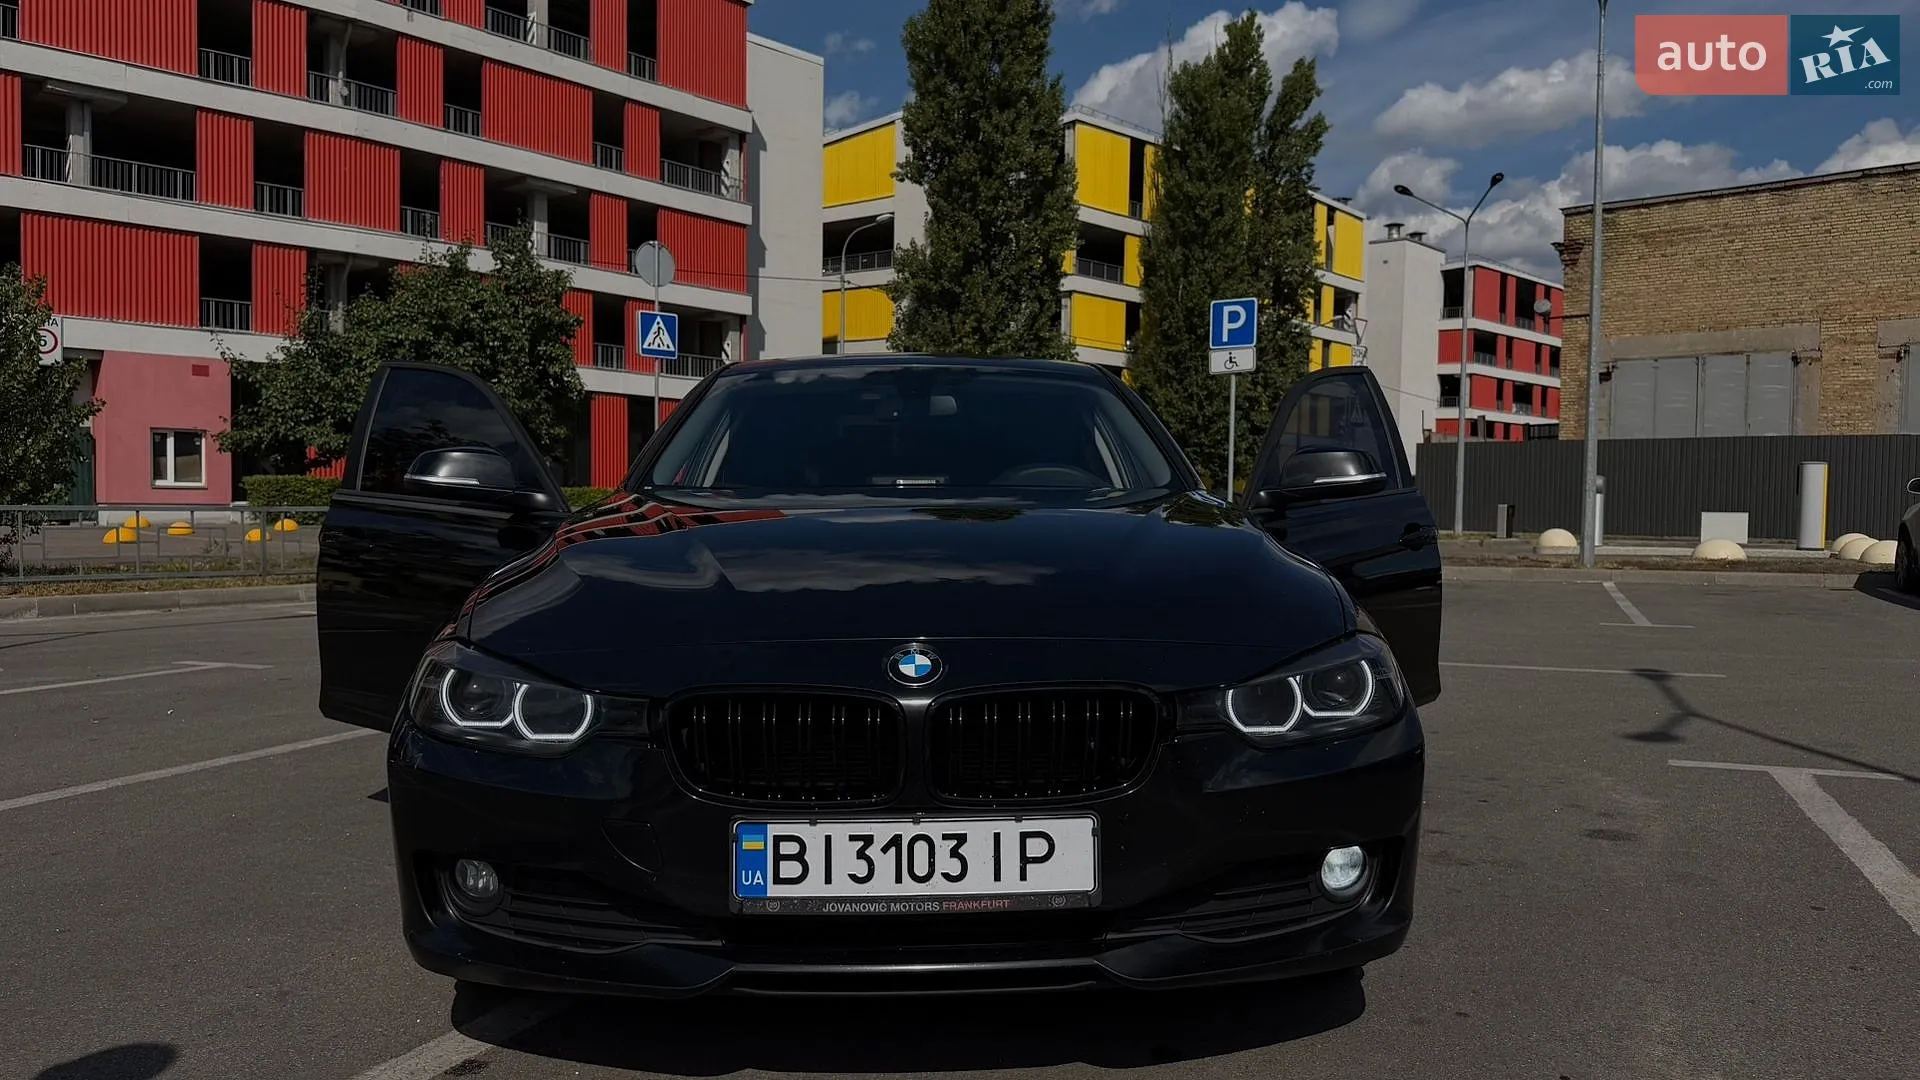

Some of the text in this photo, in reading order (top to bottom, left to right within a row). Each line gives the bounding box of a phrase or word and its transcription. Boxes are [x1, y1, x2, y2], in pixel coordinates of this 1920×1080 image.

[1222, 305, 1247, 342] P
[742, 869, 764, 886] UA
[889, 901, 940, 912] MOTORS
[942, 899, 1010, 911] FRANKFURT
